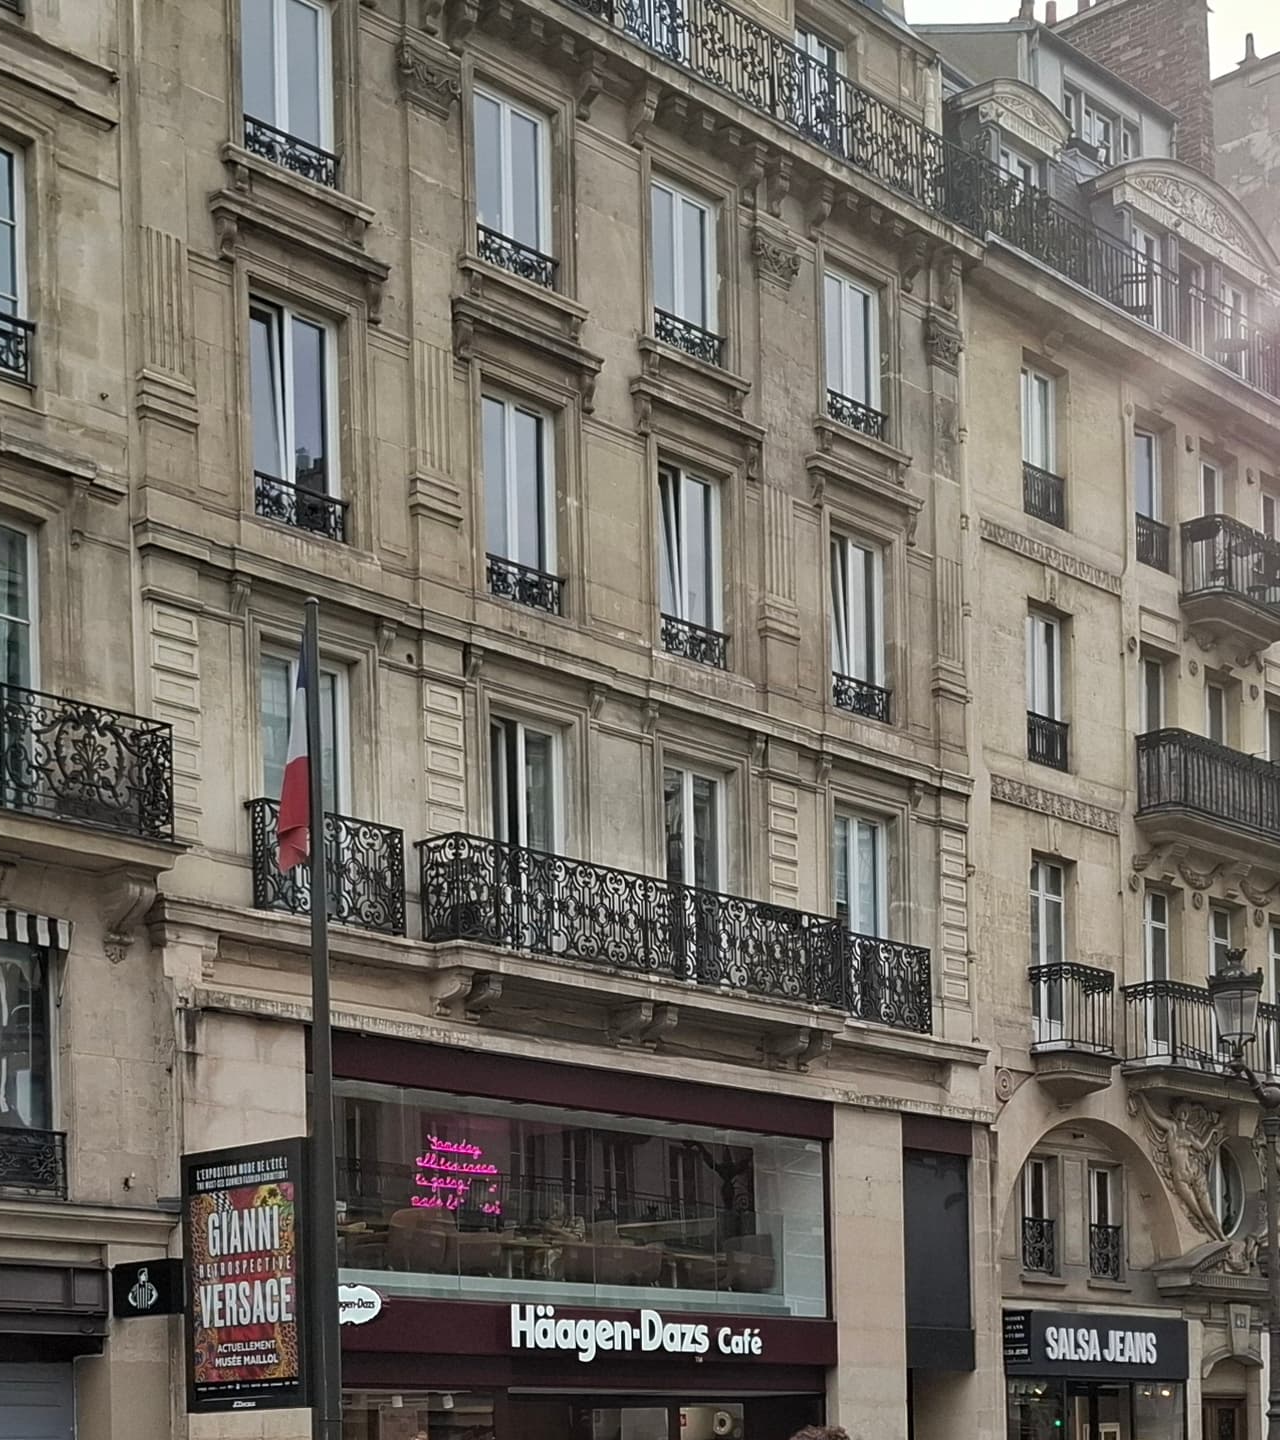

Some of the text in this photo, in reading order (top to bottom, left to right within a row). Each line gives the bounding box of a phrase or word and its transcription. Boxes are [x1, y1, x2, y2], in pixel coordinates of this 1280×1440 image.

[208, 1204, 280, 1257] GIANNI
[199, 1255, 291, 1278] RETROSPECTIVE
[200, 1277, 292, 1328] VERSACE
[217, 1339, 276, 1353] ACTUELLEMENT
[511, 1304, 710, 1362] Häagen-Dazs
[718, 1326, 762, 1354] Café
[1046, 1326, 1101, 1361] SALSA
[1103, 1330, 1157, 1364] JEANS
[215, 1353, 279, 1367] MUSÉE MAILLOL
